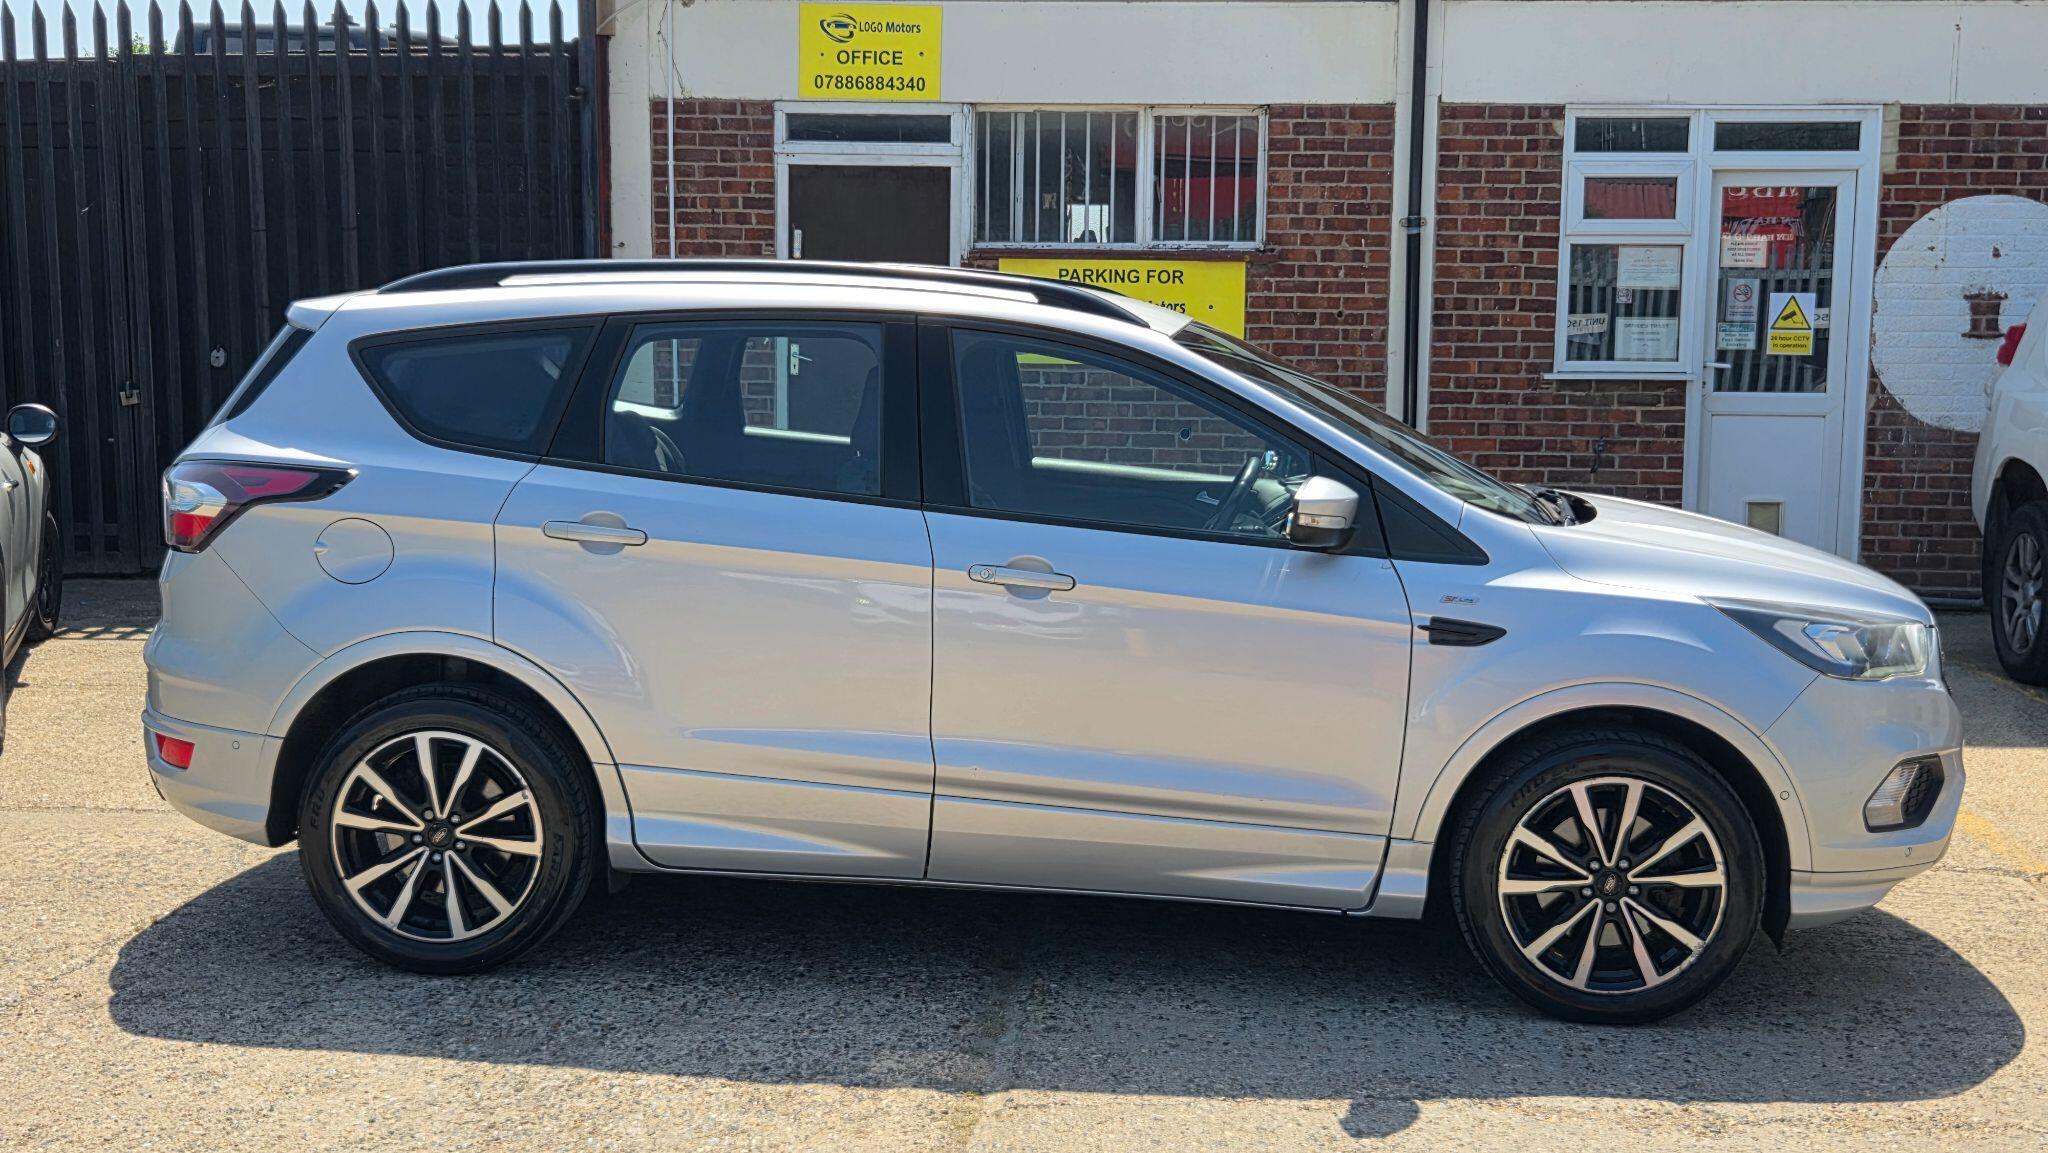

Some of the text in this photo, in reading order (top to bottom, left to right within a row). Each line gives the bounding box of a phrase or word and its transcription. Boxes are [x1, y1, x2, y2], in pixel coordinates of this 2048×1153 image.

[859, 22, 921, 33] LOGO Motors
[836, 50, 903, 65] OFFICE
[814, 74, 926, 91] 07886884340
[1058, 268, 1184, 284] PARKING FOR
